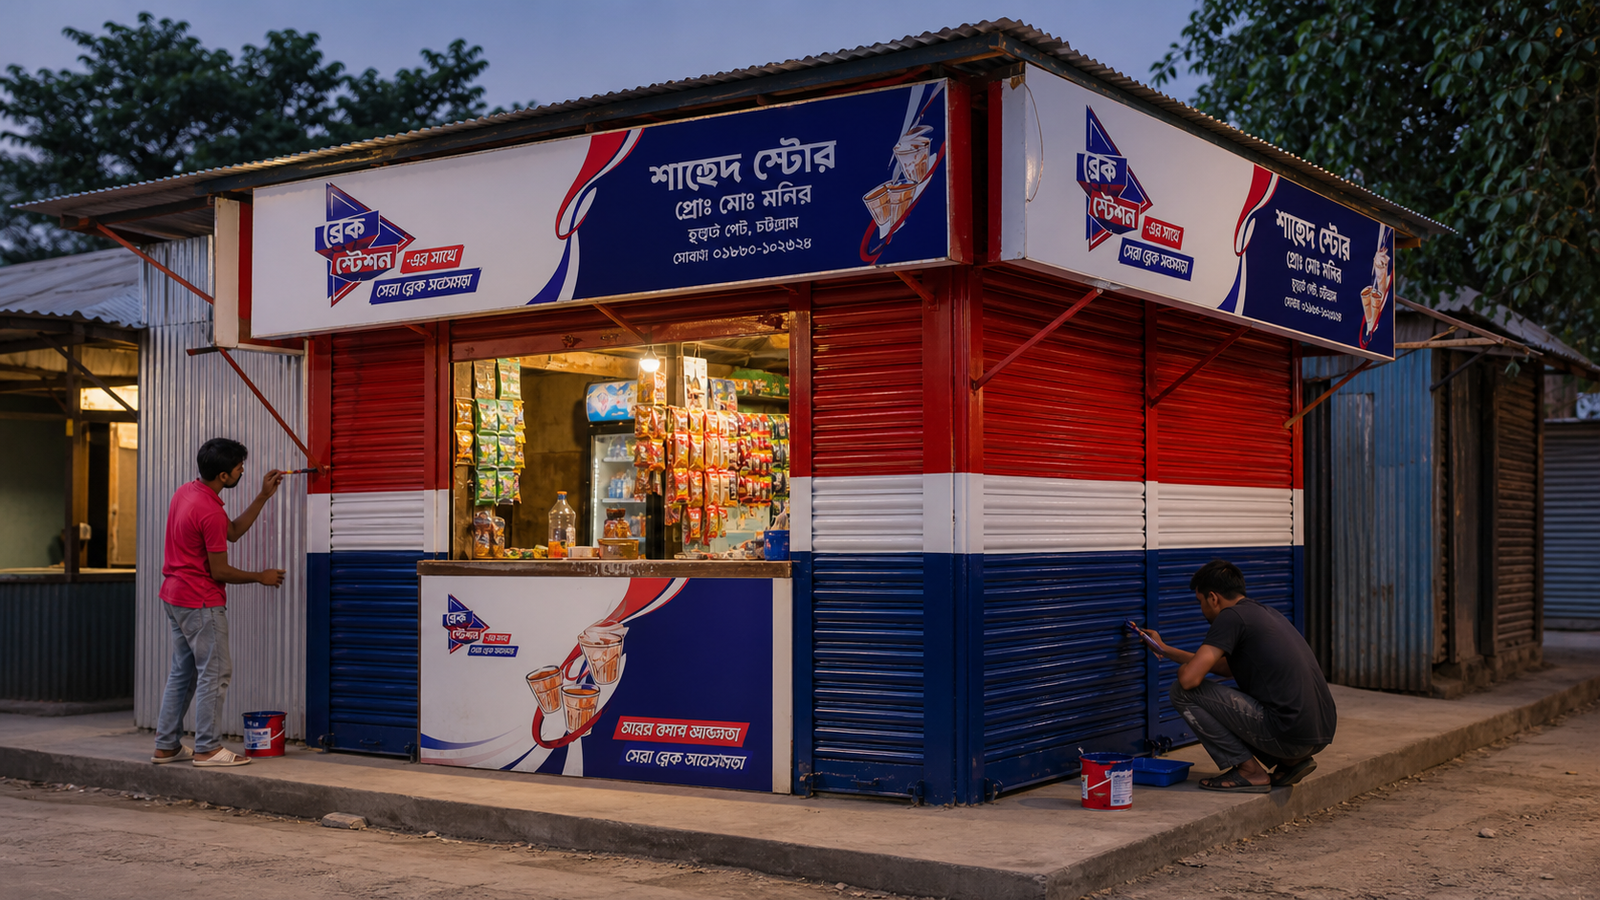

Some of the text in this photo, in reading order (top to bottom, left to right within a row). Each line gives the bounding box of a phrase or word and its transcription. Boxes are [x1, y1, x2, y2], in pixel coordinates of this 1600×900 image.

[649, 137, 837, 191] শাহেদ স্টোর
[1083, 153, 1117, 183] ব্রেক
[719, 192, 755, 214] মোঃ
[761, 181, 813, 207] মনির
[1093, 191, 1136, 228] স্টেশন
[323, 217, 366, 249] ব্রেক
[1275, 208, 1351, 262] শাহেদ স্টোর
[336, 250, 393, 275] স্টেশন
[407, 248, 459, 267] -এর সাথে
[376, 283, 402, 298] সেরা
[625, 749, 655, 764] সেরা
